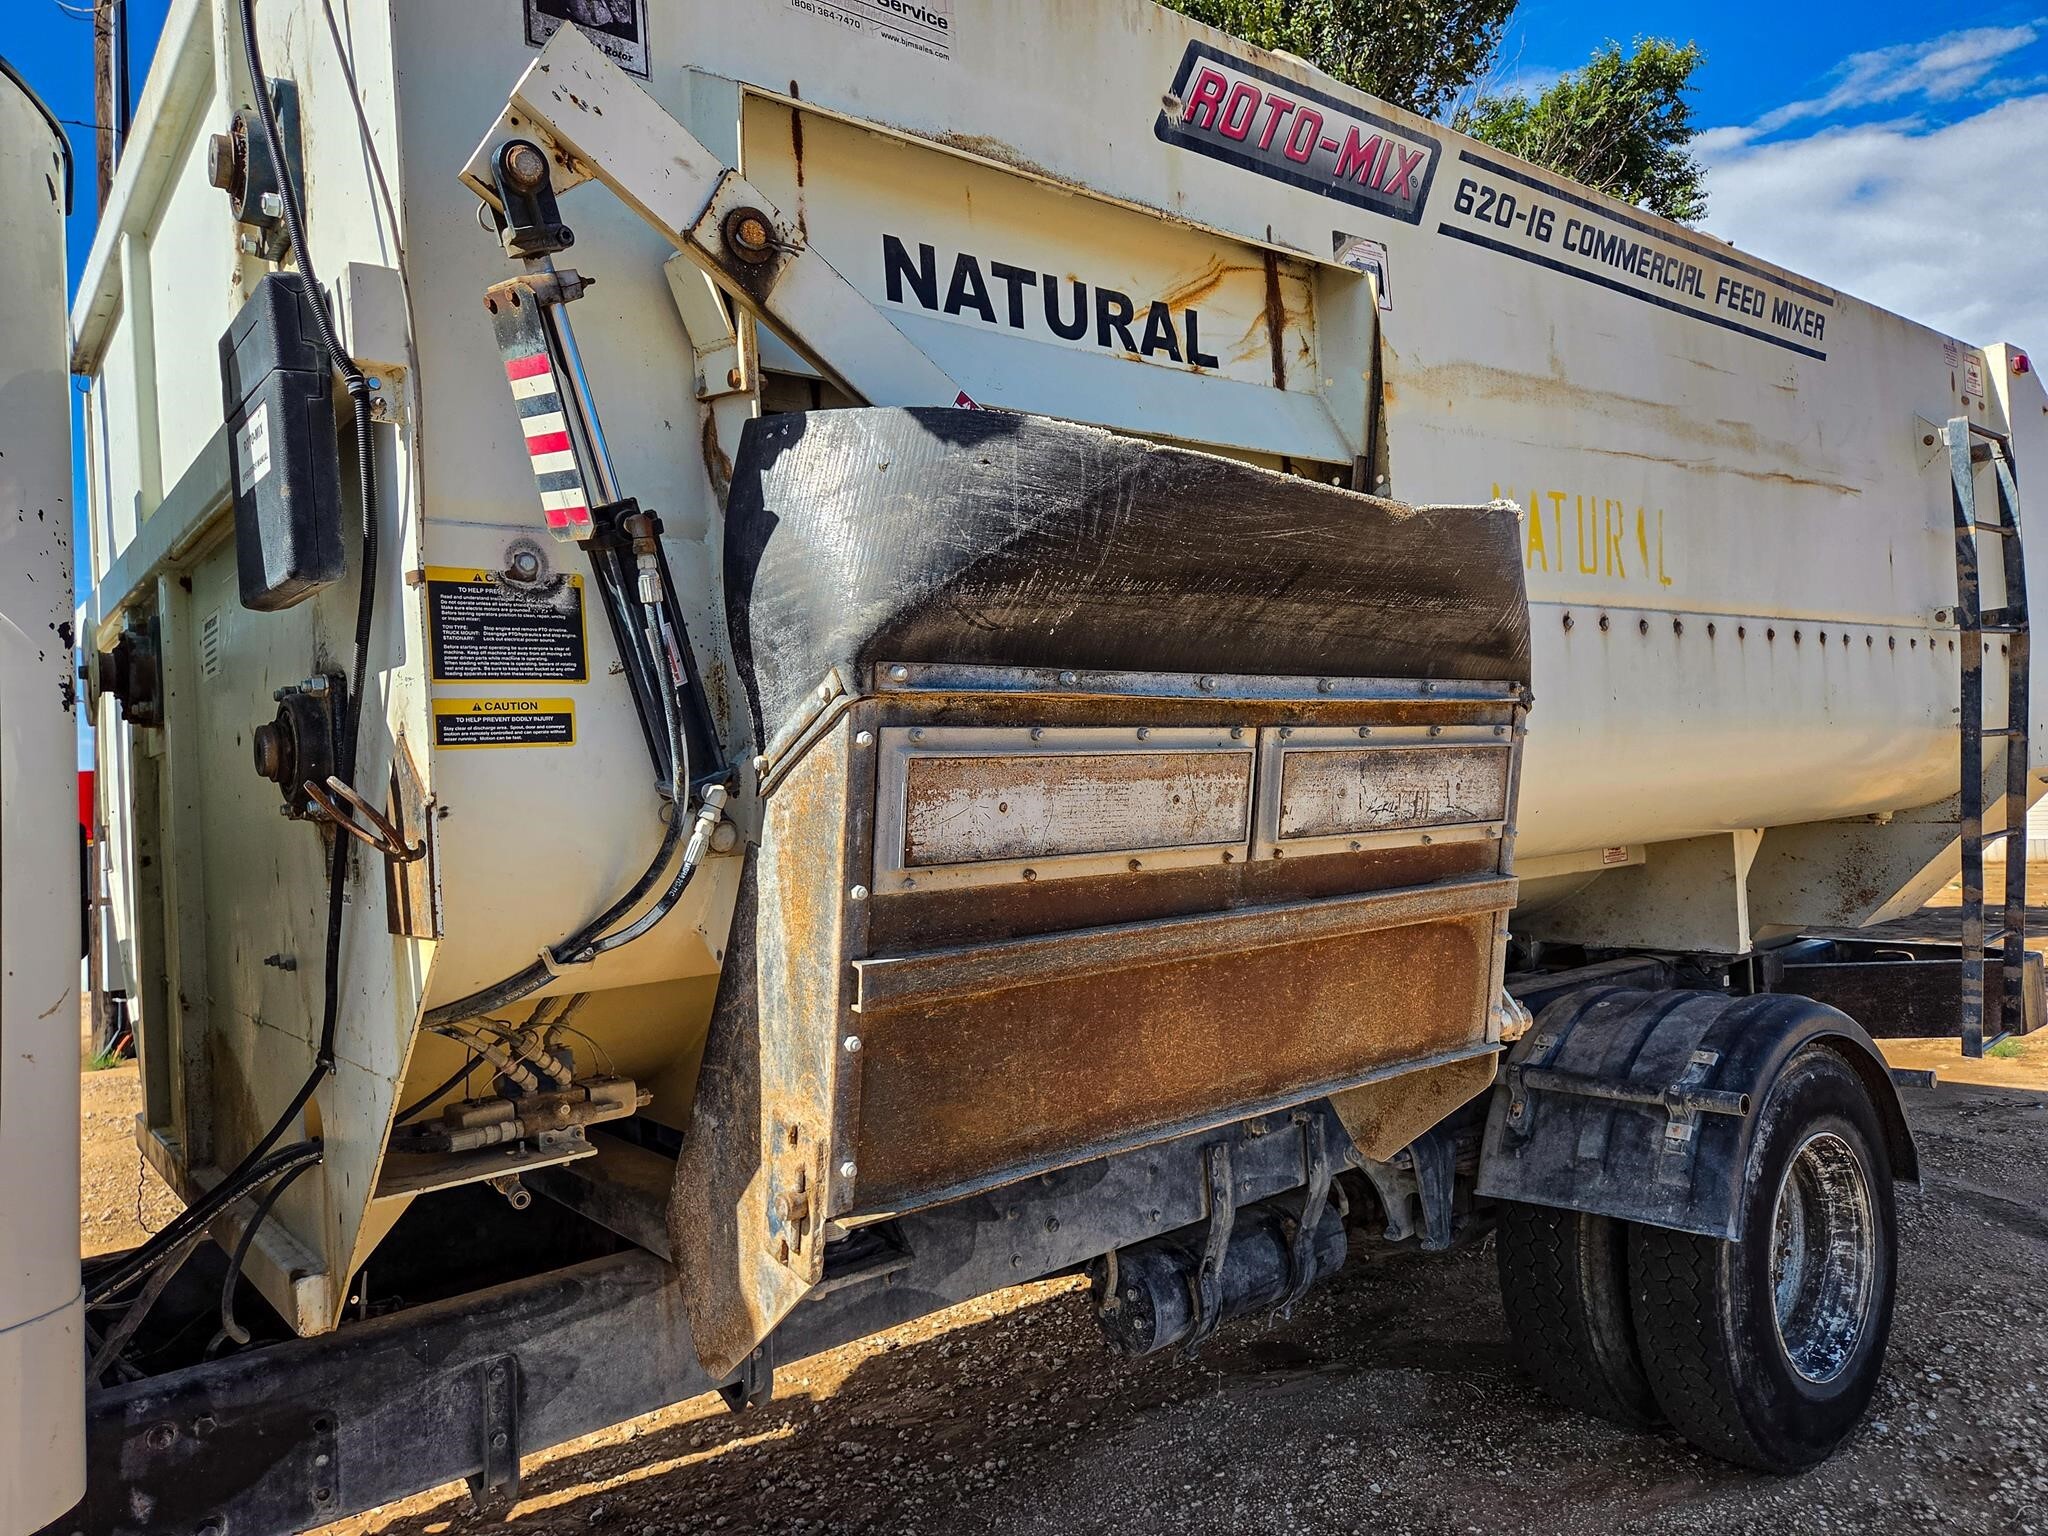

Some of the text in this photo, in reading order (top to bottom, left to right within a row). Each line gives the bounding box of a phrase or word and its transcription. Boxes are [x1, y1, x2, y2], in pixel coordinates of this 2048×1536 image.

[817, 7, 861, 29] 364-7470
[604, 45, 634, 62] Rotor
[880, 31, 950, 61] www.bjmsales.com
[1183, 66, 1424, 201] ROTO-MIX
[1453, 177, 1826, 341] 620-16 COMMERCIAL FEED MIXER
[882, 233, 1219, 369] NATURAL
[484, 701, 538, 711] CAUTION
